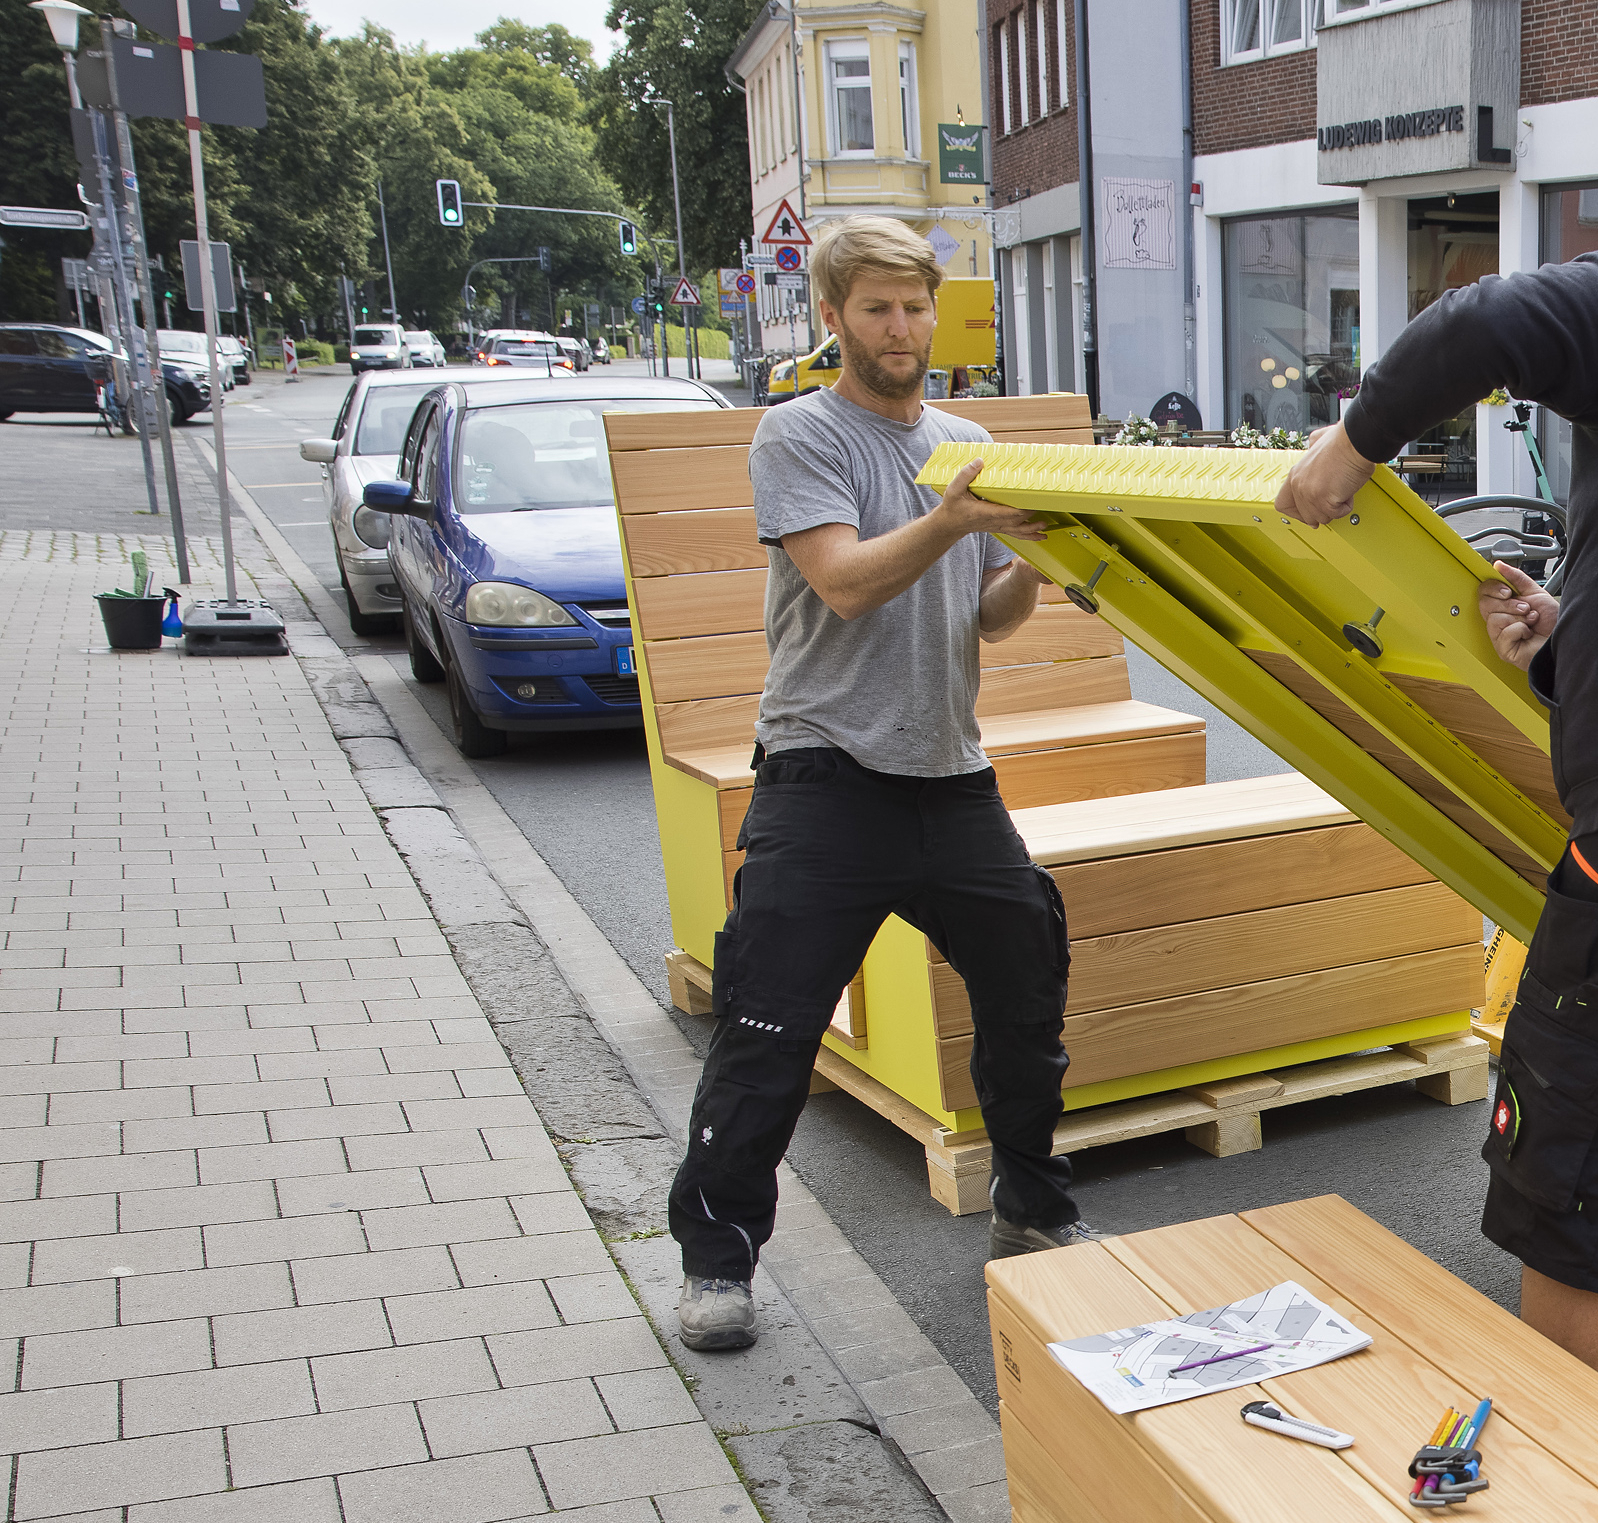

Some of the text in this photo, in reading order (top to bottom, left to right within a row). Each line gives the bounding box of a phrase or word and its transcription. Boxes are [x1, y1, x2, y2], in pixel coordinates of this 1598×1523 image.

[1318, 105, 1463, 151] LUDEWIG KONZEPTE
[1477, 105, 1511, 163] L
[948, 171, 977, 179] BECK'S
[621, 662, 628, 670] D
